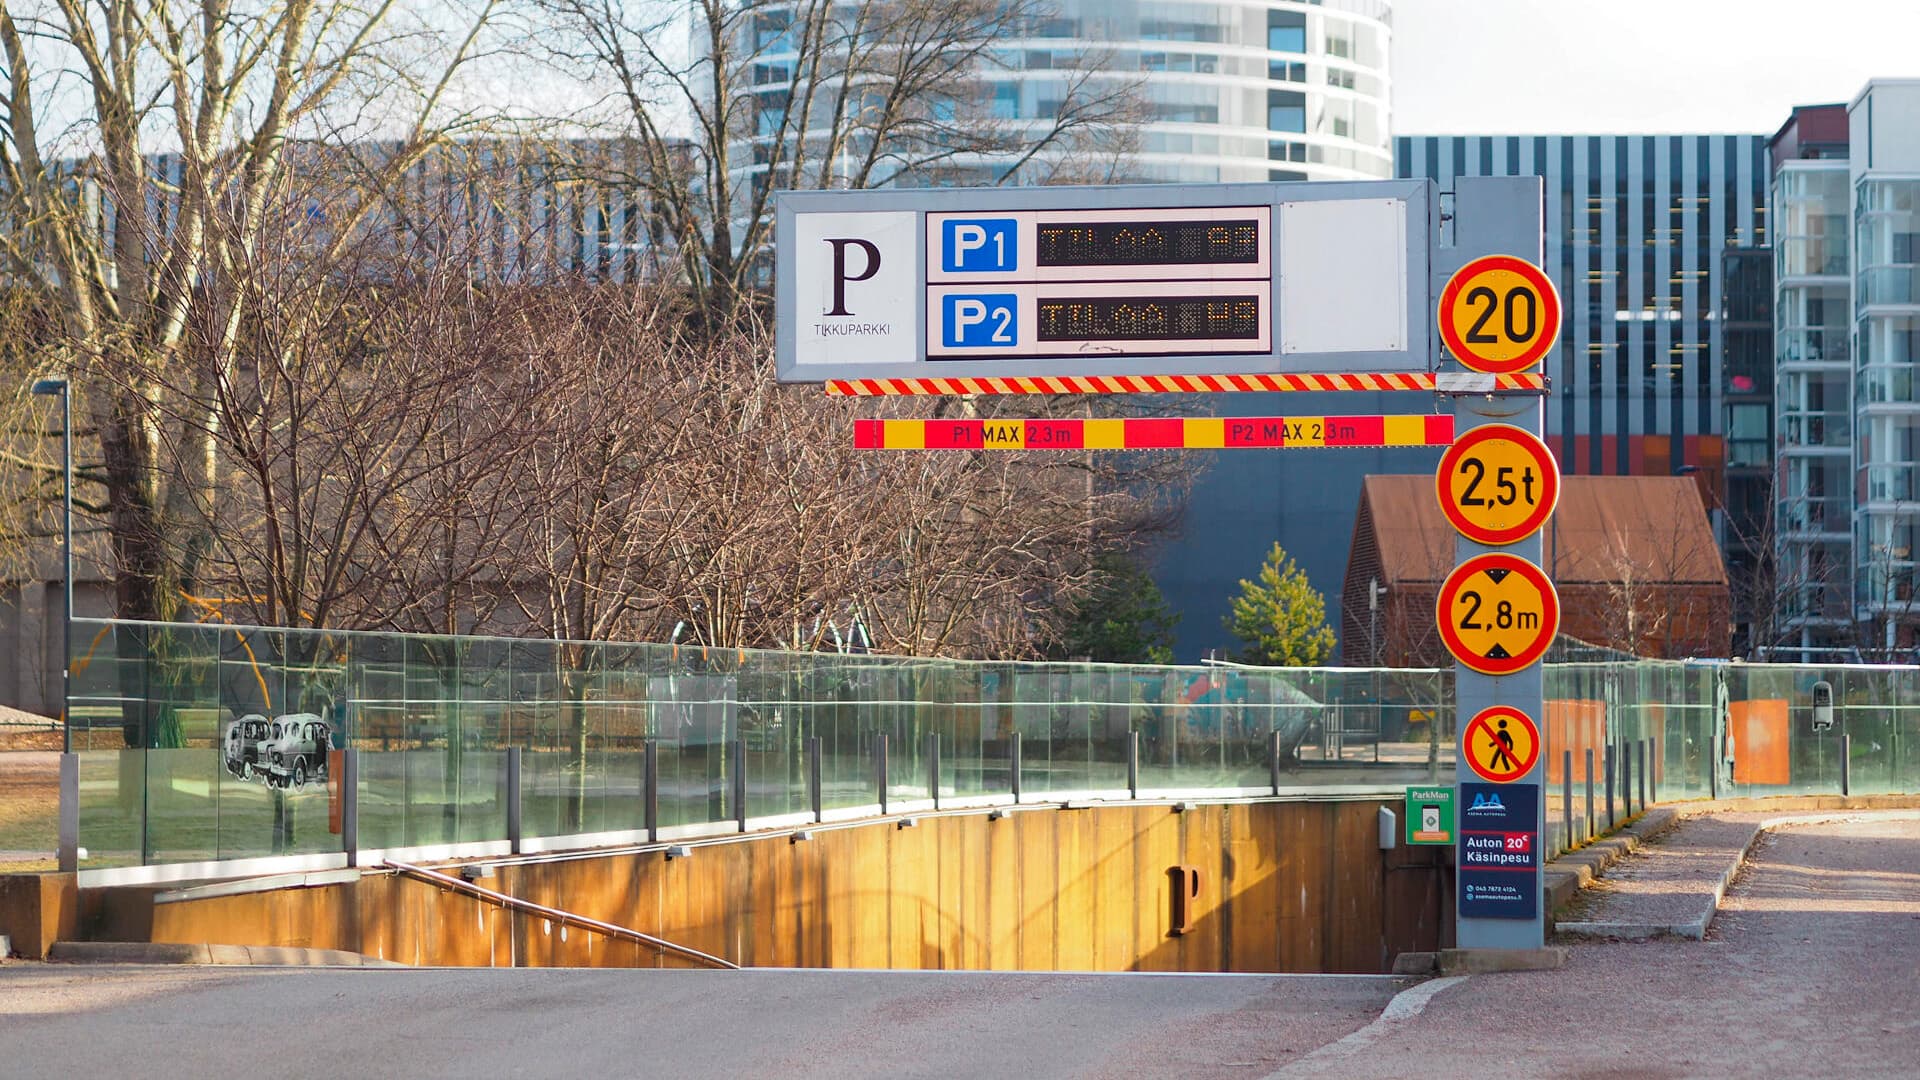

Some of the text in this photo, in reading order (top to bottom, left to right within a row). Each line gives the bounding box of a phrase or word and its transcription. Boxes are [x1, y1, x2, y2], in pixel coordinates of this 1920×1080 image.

[955, 224, 1004, 267] P1
[823, 239, 881, 316] P
[955, 299, 1012, 343] P2
[1466, 287, 1536, 343] 20
[814, 323, 890, 336] TIKKUPARKKI
[953, 427, 971, 442] P1
[981, 426, 1020, 442] MAX
[1232, 425, 1254, 441] P2
[1264, 424, 1303, 440] MAX
[1412, 791, 1449, 799] ParkMan
[1466, 837, 1503, 848] Auton
[1467, 851, 1530, 864] Käsinpesu
